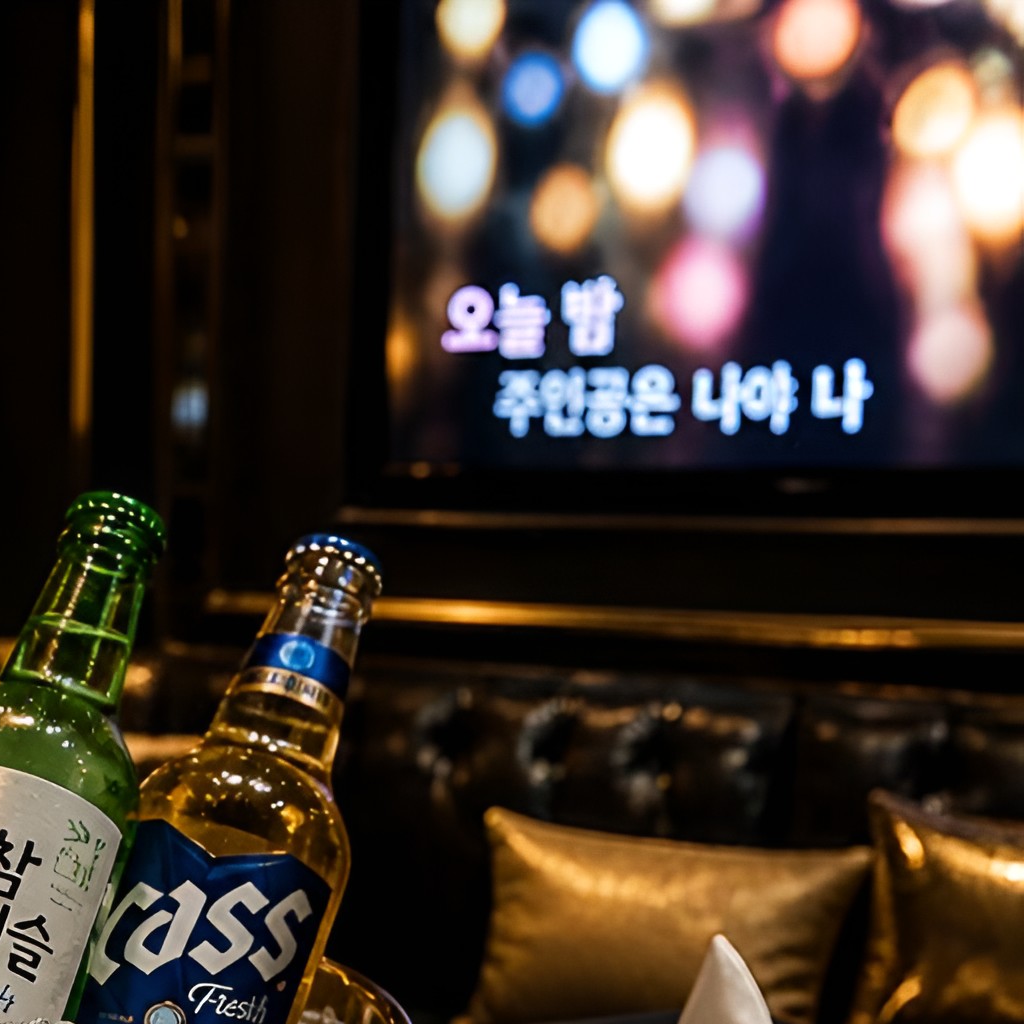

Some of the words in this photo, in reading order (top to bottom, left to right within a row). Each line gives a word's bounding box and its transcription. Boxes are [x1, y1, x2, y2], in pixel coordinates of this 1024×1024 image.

[441, 282, 551, 360] 오늘
[493, 364, 682, 438] 주인공은
[691, 359, 799, 435] 나야
[811, 357, 874, 434] 나
